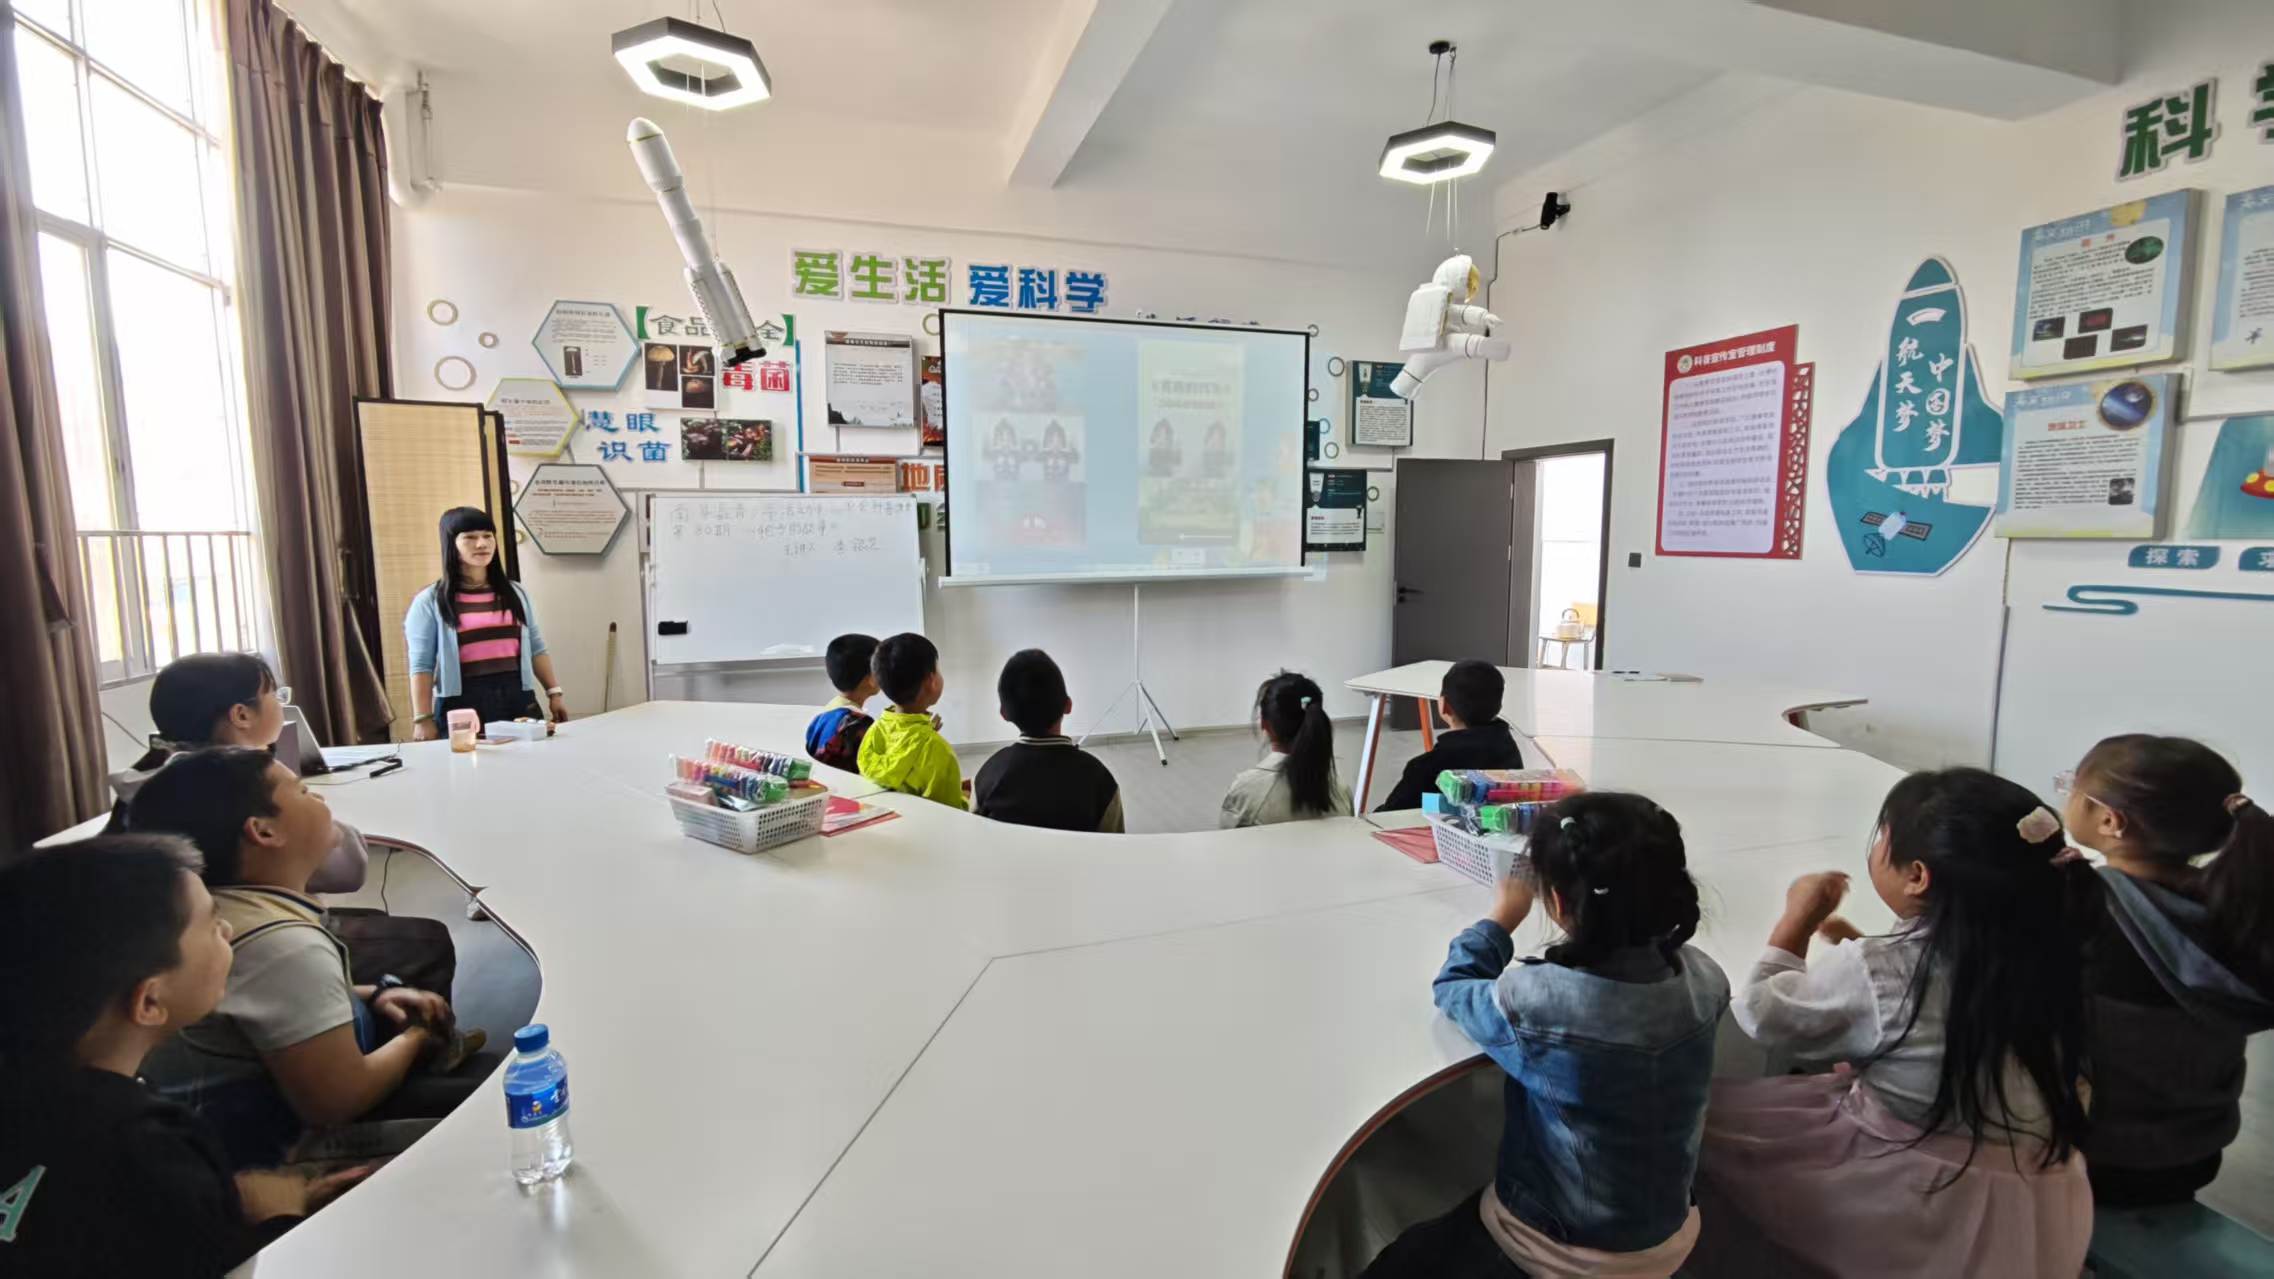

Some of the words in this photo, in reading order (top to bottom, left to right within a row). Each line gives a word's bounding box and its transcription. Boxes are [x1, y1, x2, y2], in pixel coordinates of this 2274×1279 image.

[794, 250, 946, 302] 爱生活
[969, 264, 1104, 313] 爱科学
[650, 314, 784, 340] 食品全
[1893, 337, 1924, 432] 航天梦
[1924, 353, 1953, 451] 中国梦
[586, 410, 661, 433] 慧眼
[597, 440, 671, 462] 识菌
[2146, 547, 2199, 567] 探索
